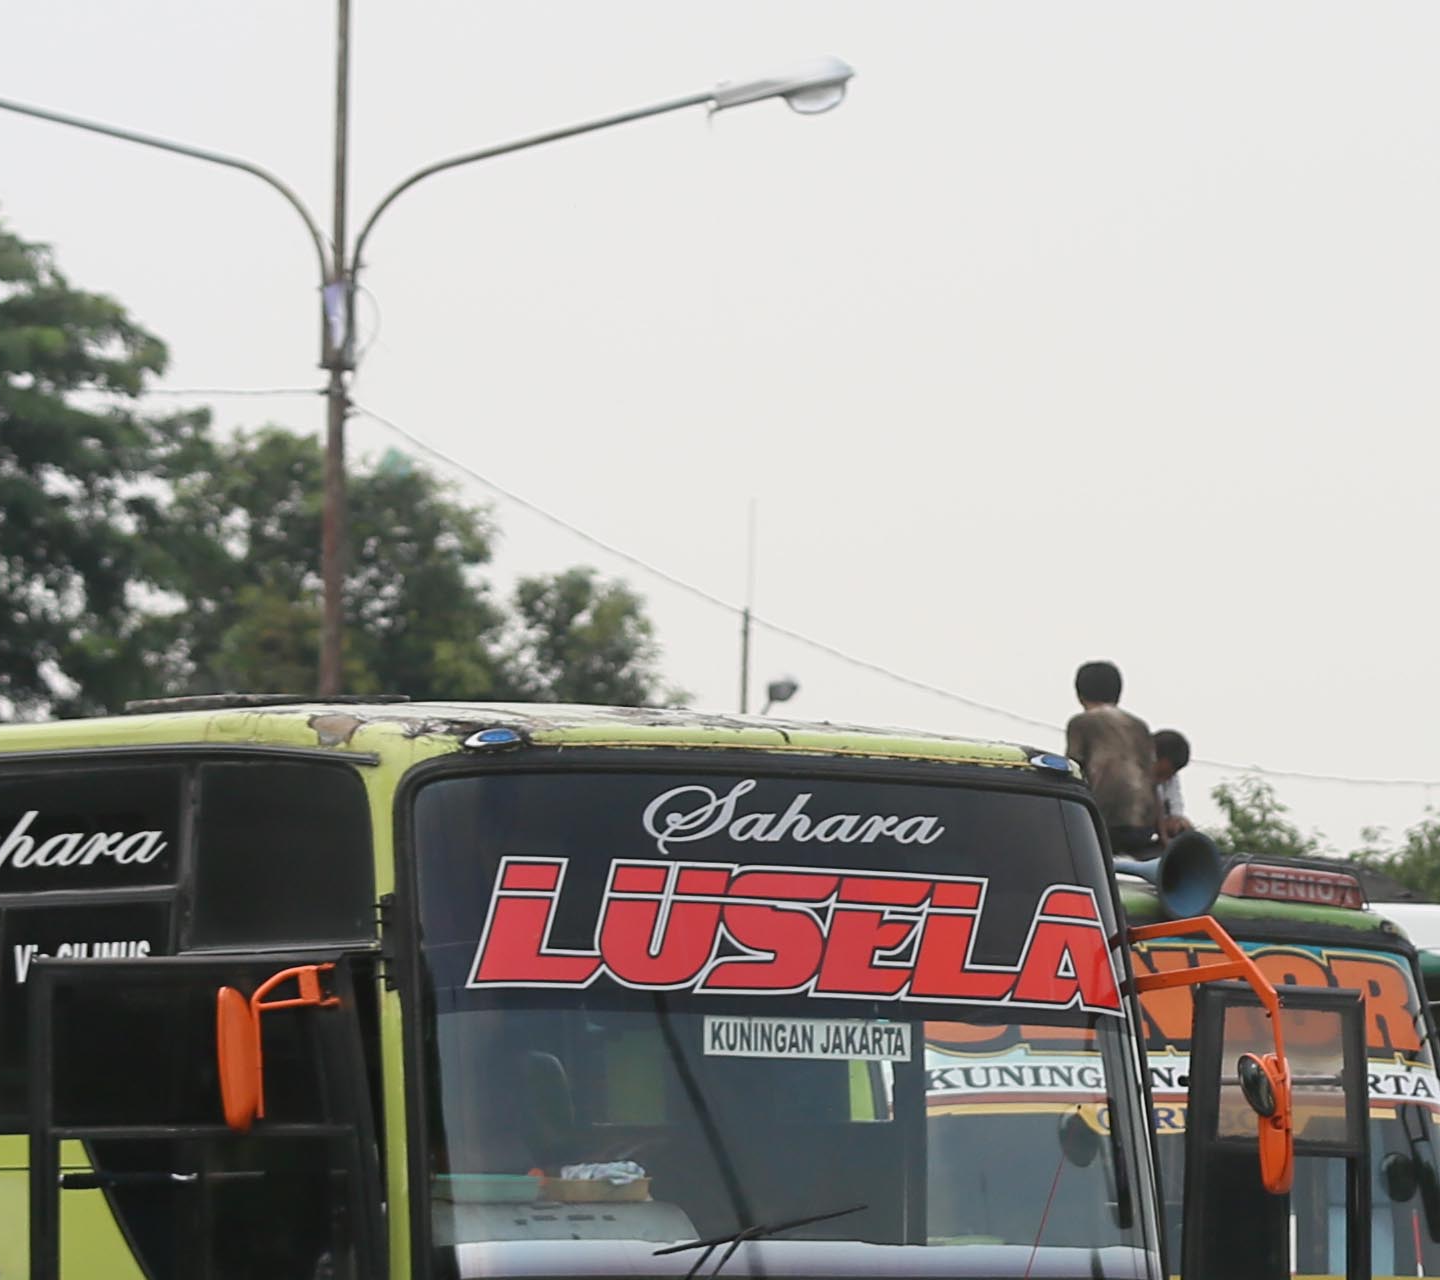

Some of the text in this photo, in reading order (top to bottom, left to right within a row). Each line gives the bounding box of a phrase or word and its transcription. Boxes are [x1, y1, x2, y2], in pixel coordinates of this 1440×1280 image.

[643, 778, 945, 855] Sahara
[466, 856, 1125, 1017] LUSELA
[711, 1021, 906, 1056] KUNINGAN JAKARTA
